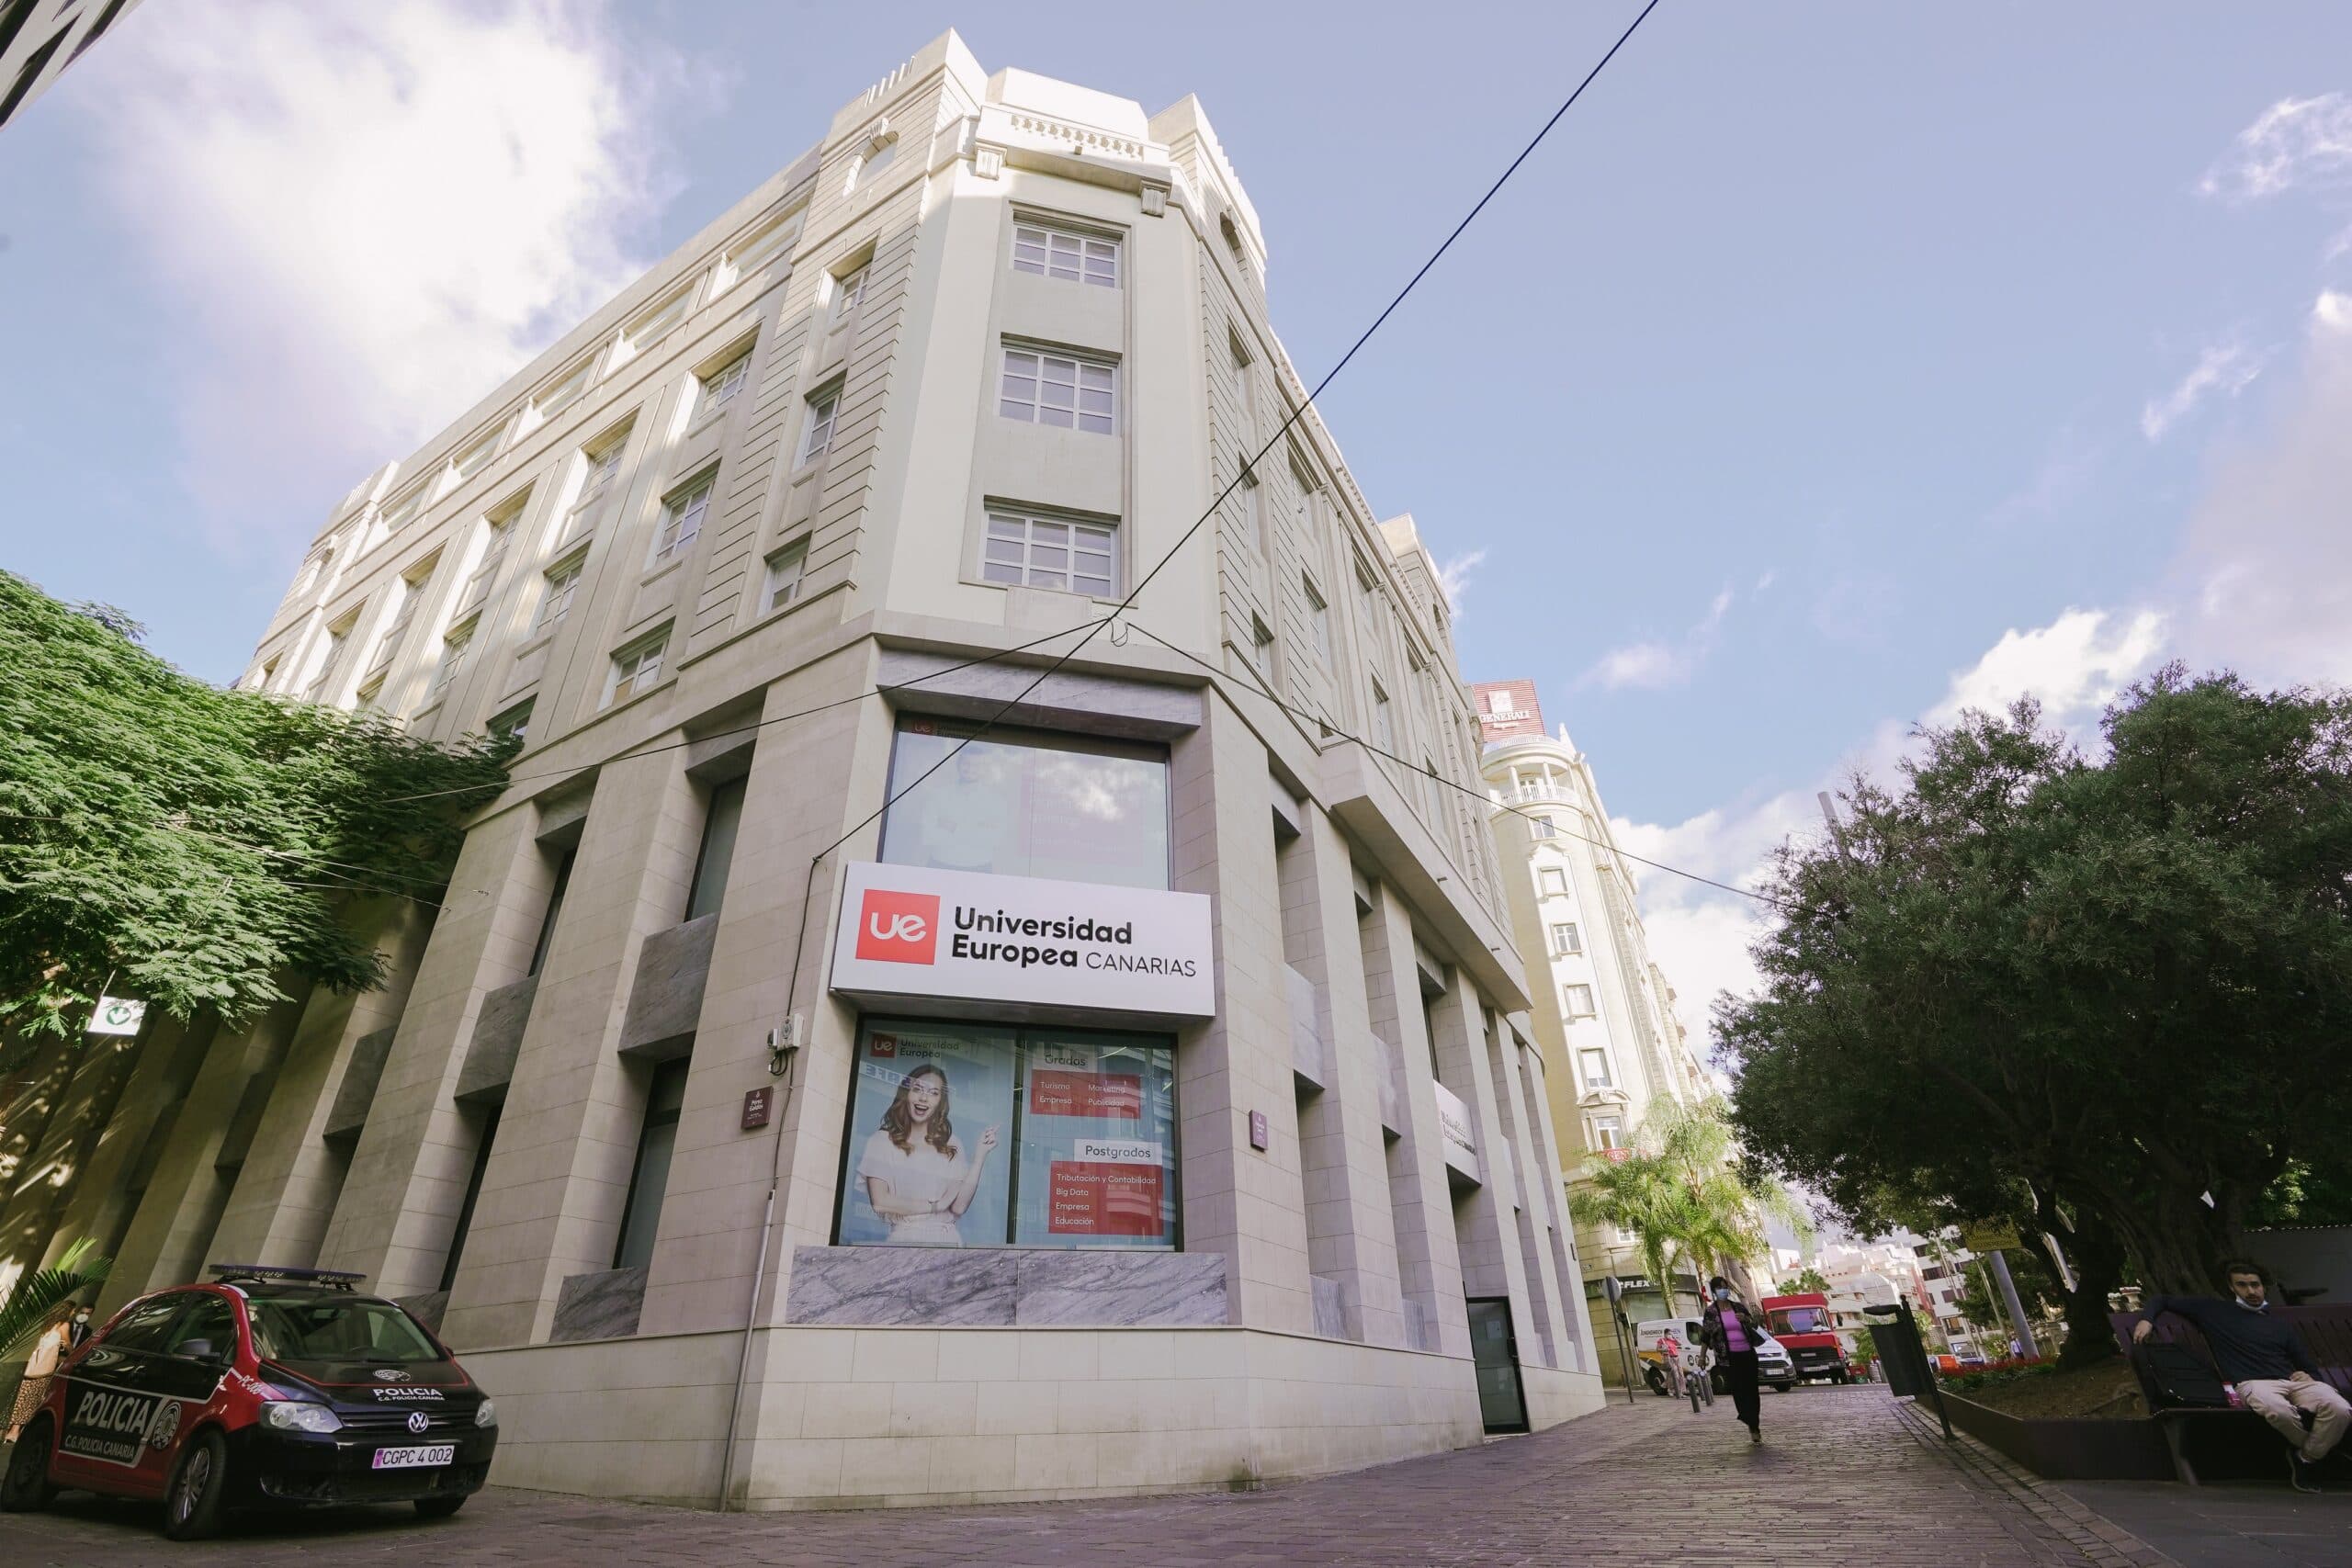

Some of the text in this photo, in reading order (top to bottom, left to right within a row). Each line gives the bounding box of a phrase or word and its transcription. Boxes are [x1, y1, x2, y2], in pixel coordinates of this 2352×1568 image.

[869, 911, 927, 942] ue
[955, 906, 1132, 944] Universidad
[952, 934, 1197, 977] Europea CANARIAS
[874, 1040, 893, 1052] ue
[900, 1039, 959, 1051] Universidad
[899, 1048, 941, 1058] Europea
[1045, 1055, 1087, 1066] Grados
[1040, 1082, 1070, 1090] Turismo
[1088, 1083, 1125, 1094] Marketing
[1039, 1095, 1072, 1106] Empresa
[1088, 1098, 1125, 1107] Publicidad
[1085, 1145, 1151, 1159] Postgrados
[1057, 1174, 1101, 1182] Tributación
[1108, 1176, 1157, 1184] Contabilidad
[1056, 1188, 1089, 1197] Big Data
[1056, 1202, 1090, 1212] Empresa
[1055, 1216, 1094, 1225] Educación
[372, 1388, 443, 1396] POLICIA
[74, 1391, 152, 1435] POLICIA
[78, 1437, 103, 1454] POLICIA
[103, 1439, 135, 1459] CANARIA
[382, 1448, 453, 1465] CGPC 4 002
